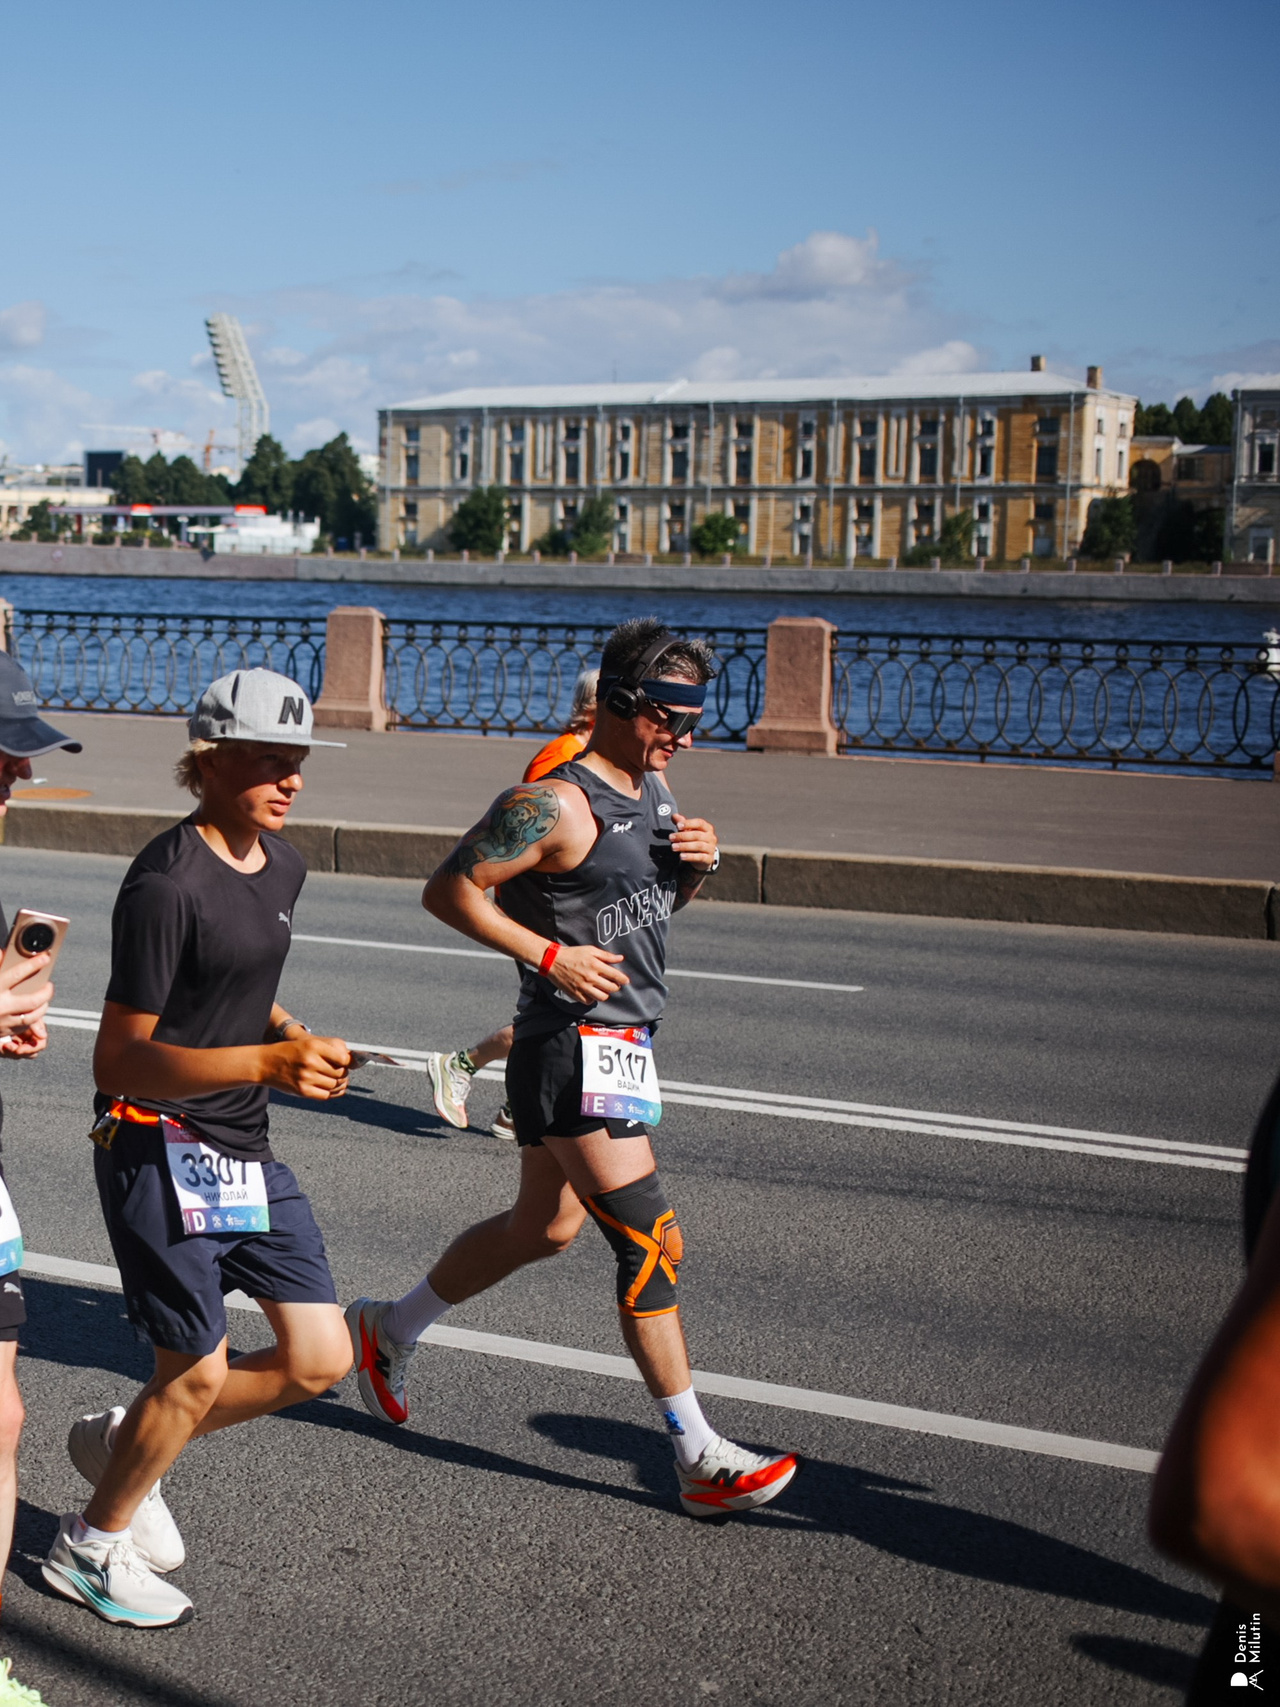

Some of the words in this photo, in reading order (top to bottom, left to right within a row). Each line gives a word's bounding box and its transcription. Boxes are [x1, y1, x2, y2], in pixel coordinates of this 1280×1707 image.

[278, 696, 304, 725] N
[596, 887, 652, 946] ONE
[598, 1045, 646, 1083] 5117
[592, 1096, 606, 1113] E
[181, 1152, 247, 1187] 3307
[204, 1189, 248, 1202] НИКОЛАЙ
[192, 1211, 206, 1231] D
[710, 1467, 744, 1488] N
